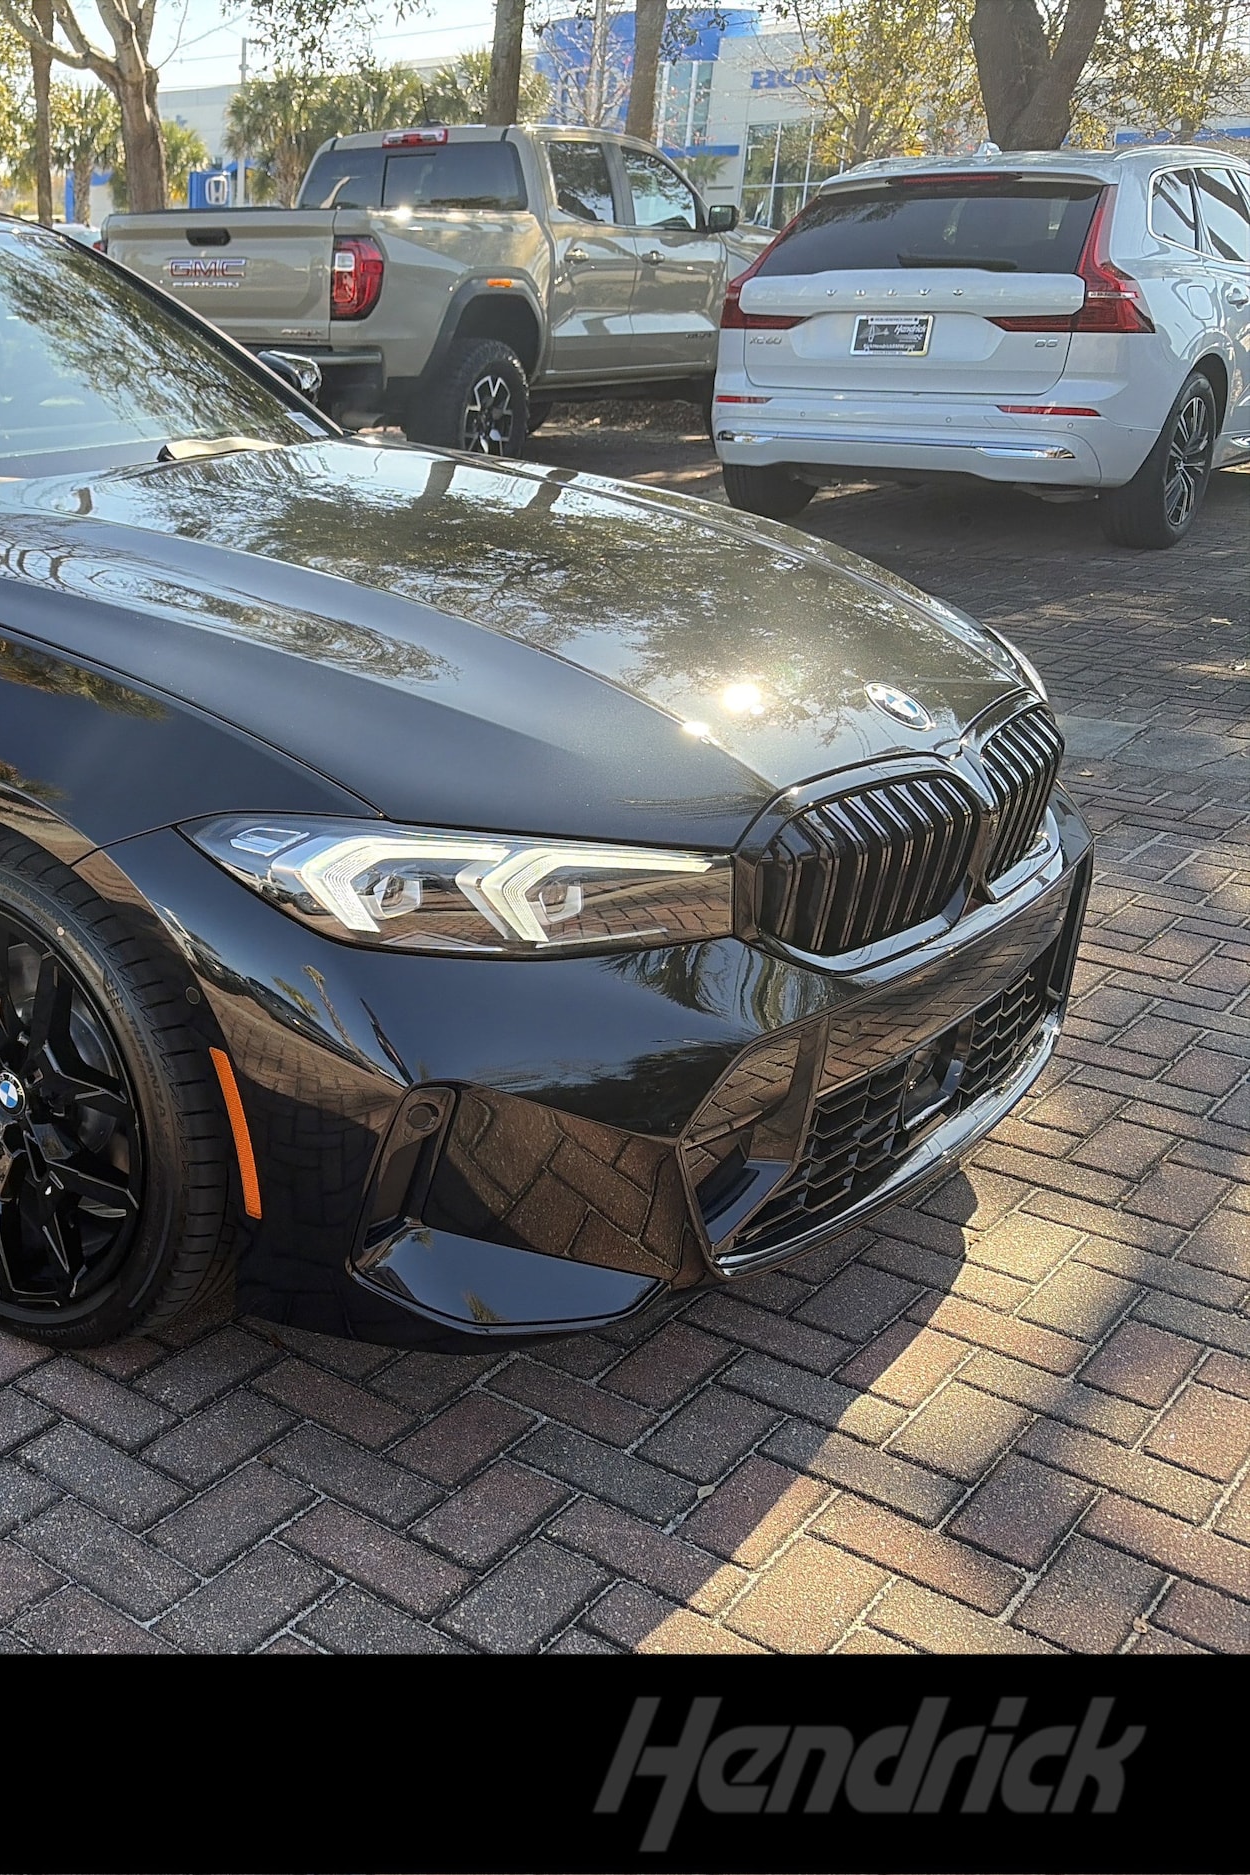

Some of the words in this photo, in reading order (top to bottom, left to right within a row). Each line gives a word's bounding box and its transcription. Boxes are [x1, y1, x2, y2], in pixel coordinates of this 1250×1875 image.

[169, 259, 247, 277] GMC
[826, 288, 964, 297] VOLVO
[749, 336, 783, 345] XC60
